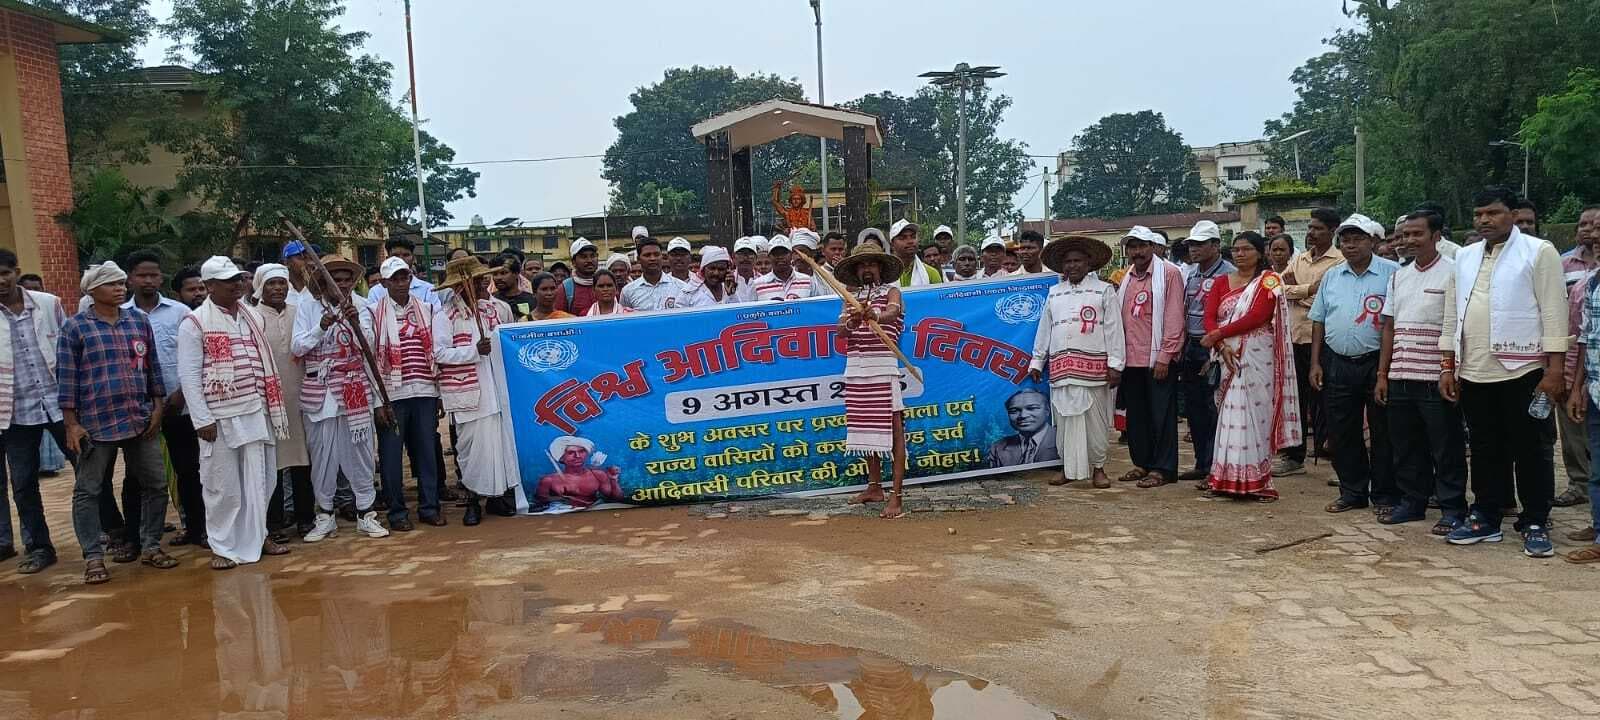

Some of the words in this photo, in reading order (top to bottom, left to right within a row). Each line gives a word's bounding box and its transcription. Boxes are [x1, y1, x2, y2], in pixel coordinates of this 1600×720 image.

[535, 359, 650, 435] विश्व
[911, 317, 1033, 385] दिवस
[714, 383, 819, 411] अगस्त
[629, 431, 650, 450] के
[658, 432, 695, 452] शुभ
[703, 423, 769, 442] अवसर
[776, 417, 805, 434] पर
[945, 394, 975, 416] एवं
[646, 455, 696, 475] राज्य
[704, 443, 774, 466] वासियों
[783, 438, 808, 458] को
[932, 422, 964, 442] सर्व
[632, 473, 728, 502] आदिवासी
[735, 465, 804, 491] परिवार
[811, 461, 837, 481] की
[916, 448, 981, 469] जोहार!
